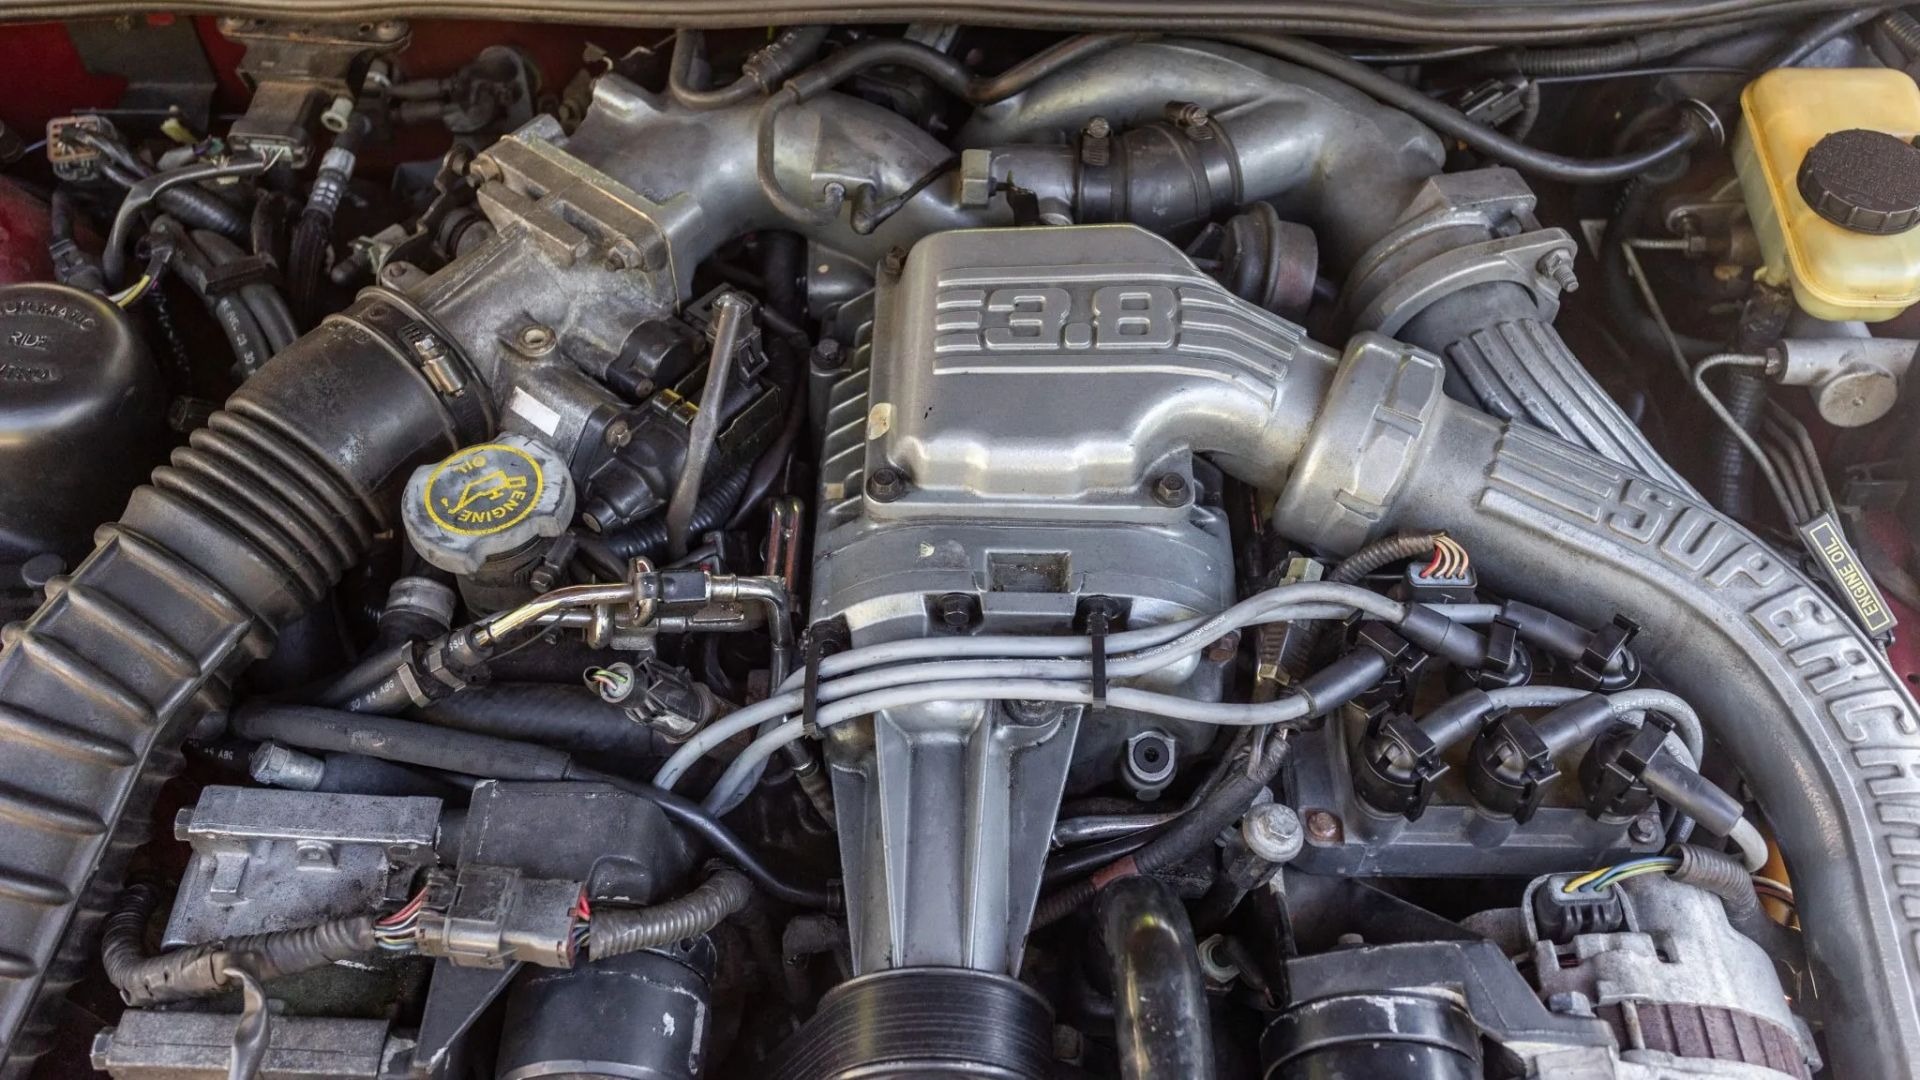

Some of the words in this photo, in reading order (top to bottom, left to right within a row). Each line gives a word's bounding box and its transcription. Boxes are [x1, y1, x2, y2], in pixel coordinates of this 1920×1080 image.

[985, 286, 1176, 350] 3.8
[455, 456, 487, 474] OIL
[458, 489, 527, 523] ENGINE
[1824, 537, 1845, 563] OIL
[1839, 563, 1879, 617] ENGINE
